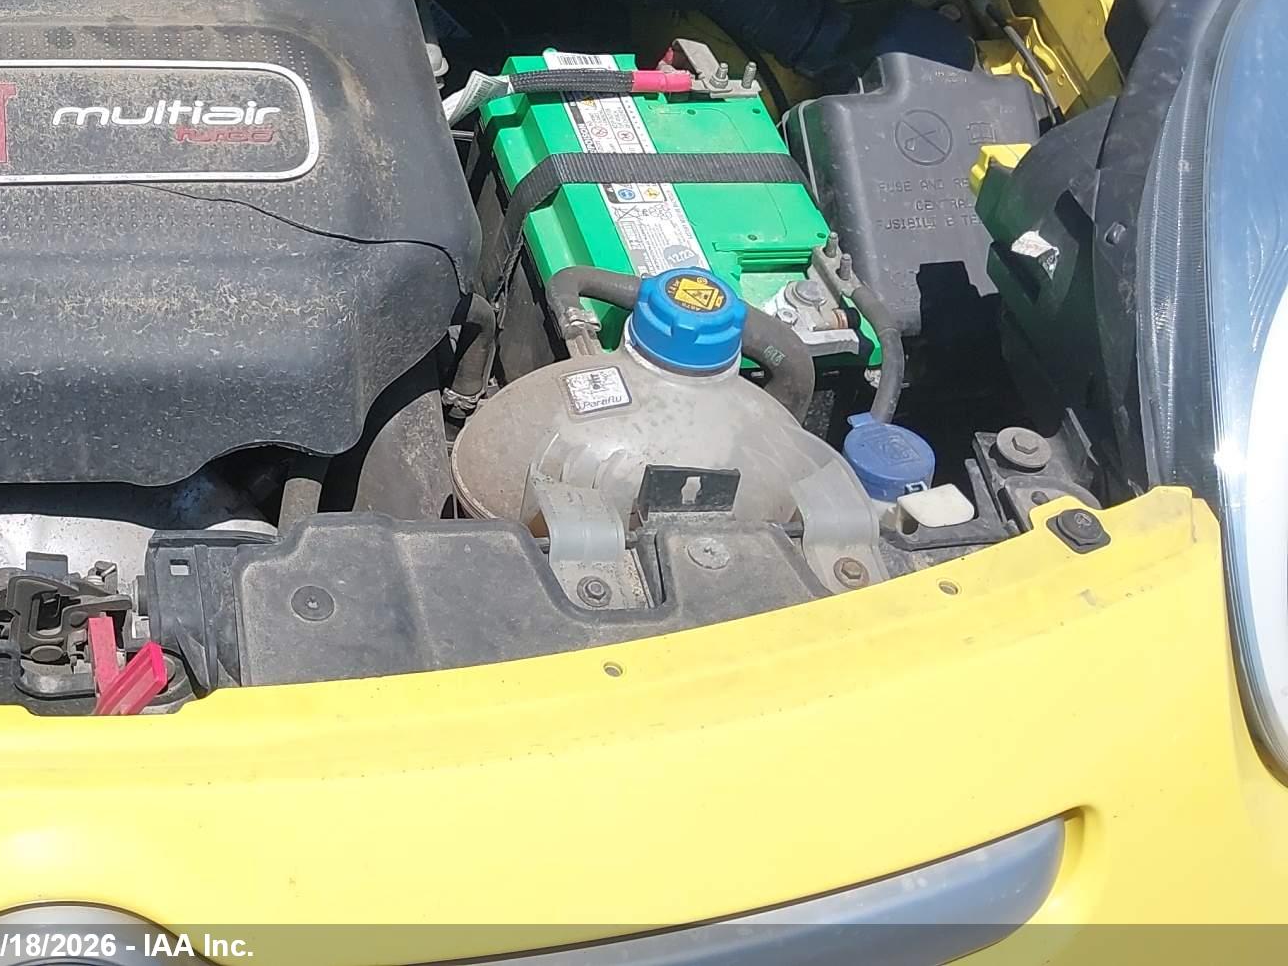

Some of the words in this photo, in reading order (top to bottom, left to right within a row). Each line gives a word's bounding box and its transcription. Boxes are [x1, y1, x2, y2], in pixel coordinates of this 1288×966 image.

[51, 99, 282, 126] multiair
[879, 181, 912, 193] FUSE
[919, 178, 944, 191] AND
